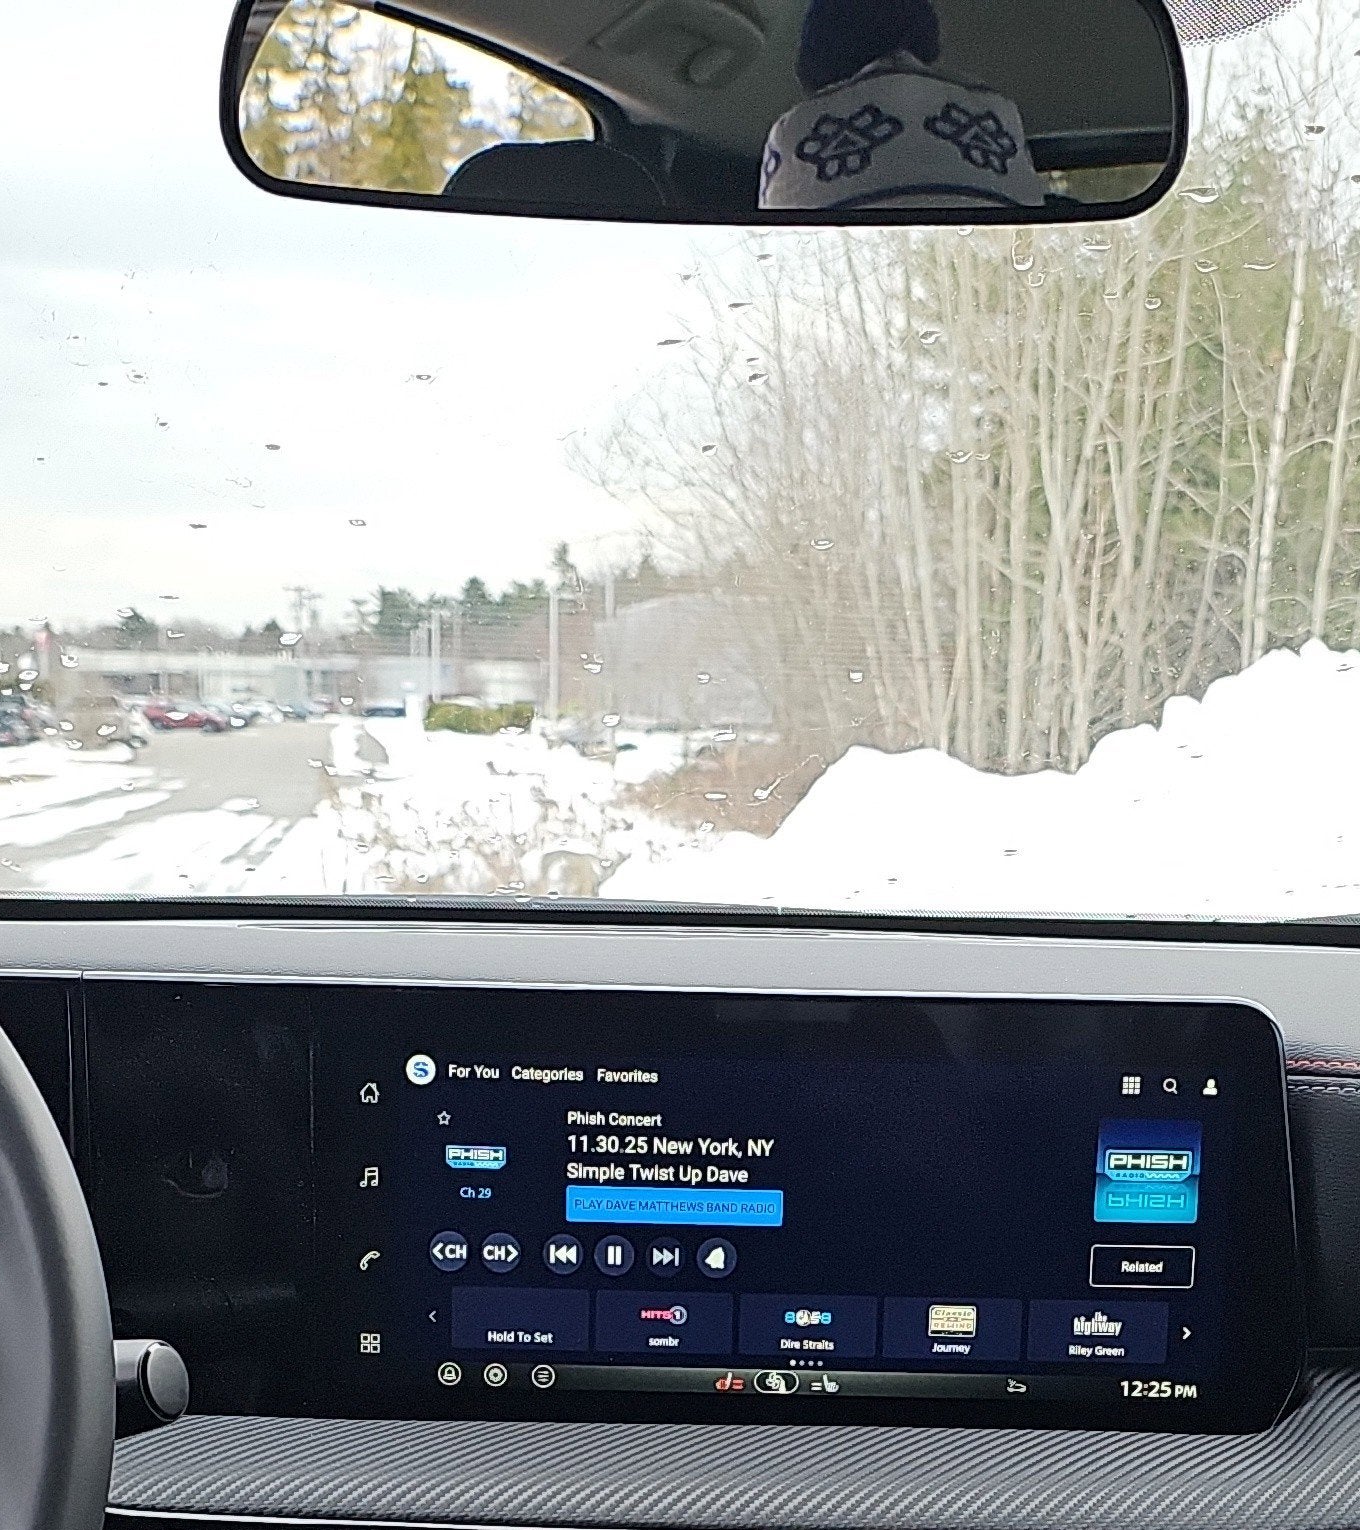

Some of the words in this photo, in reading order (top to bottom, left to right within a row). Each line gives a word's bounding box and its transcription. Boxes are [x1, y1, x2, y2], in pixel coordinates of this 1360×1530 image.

[448, 1063, 472, 1079] For
[474, 1064, 500, 1080] You
[511, 1066, 584, 1084] Categories
[596, 1068, 659, 1084] Favorites
[567, 1110, 606, 1126] Phish
[608, 1112, 663, 1127] Concert
[448, 1148, 504, 1161] PHISH
[567, 1134, 648, 1155] 11.30.25
[653, 1137, 693, 1155] New
[697, 1137, 743, 1159] York,
[748, 1139, 775, 1157] NY
[1109, 1154, 1188, 1170] PHISH
[566, 1162, 625, 1184] Simple
[629, 1163, 675, 1182] Twist
[679, 1165, 703, 1186] Up
[706, 1166, 749, 1183] Dave
[459, 1187, 476, 1199] Ch
[477, 1187, 492, 1199] 29
[574, 1198, 604, 1210] PLAY
[605, 1199, 636, 1211] DAVE
[638, 1200, 704, 1213] MATTHEWS
[706, 1202, 738, 1213] BAND
[740, 1203, 776, 1214] RADIO
[1121, 1260, 1164, 1273] Related
[487, 1330, 515, 1343] Hold
[516, 1331, 532, 1343] To
[534, 1331, 554, 1344] Set
[780, 1339, 801, 1350] Dire
[802, 1340, 835, 1350] Straits
[931, 1343, 971, 1354] Journey
[1068, 1344, 1093, 1357] Riley
[1094, 1345, 1125, 1357] Green
[1120, 1380, 1172, 1398] 12:25
[1174, 1384, 1198, 1399] PM
